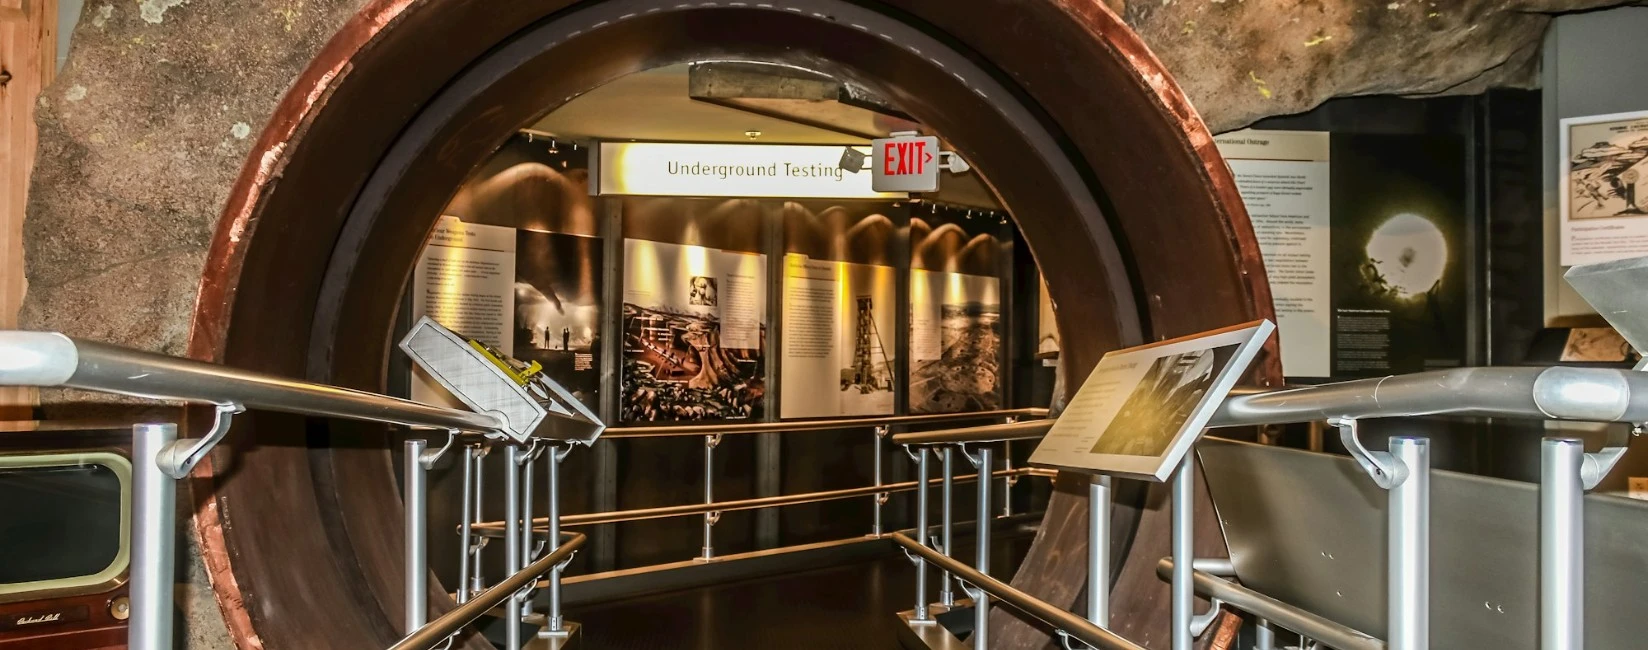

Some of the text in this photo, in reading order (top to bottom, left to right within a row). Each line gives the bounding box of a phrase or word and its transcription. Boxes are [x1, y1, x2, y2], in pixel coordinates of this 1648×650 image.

[1247, 138, 1270, 146] Outrage
[884, 141, 926, 176] EXIT
[668, 160, 843, 182] Underground Testing
